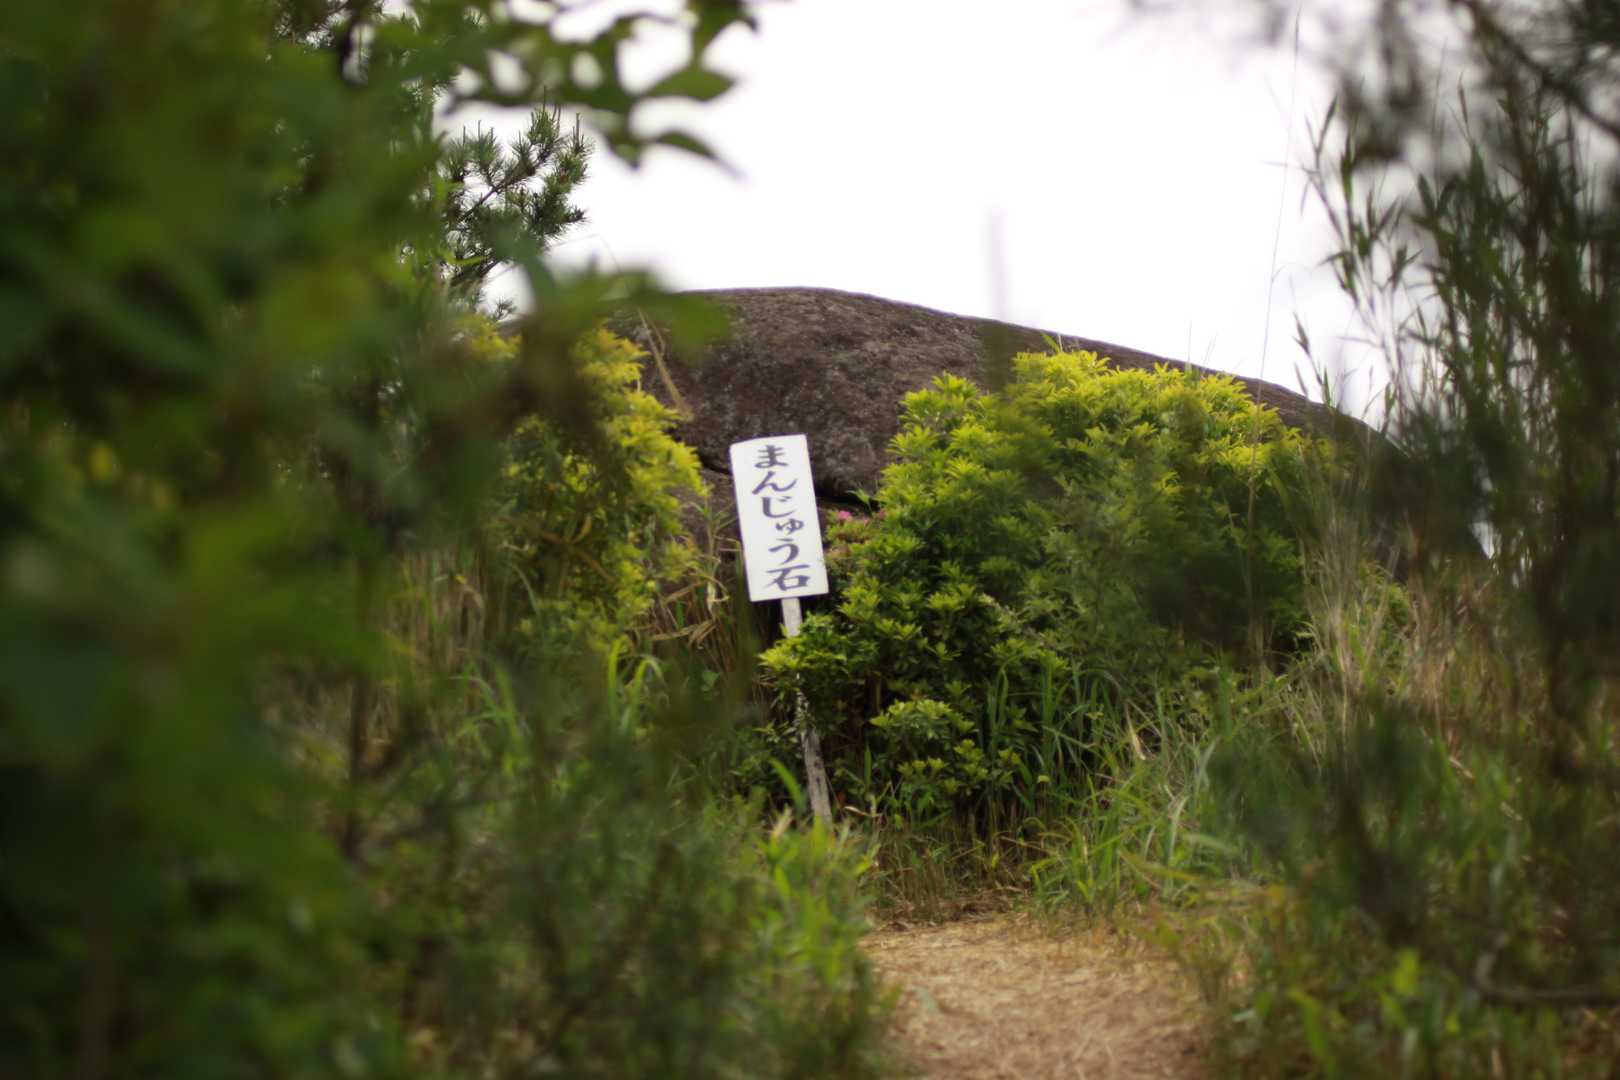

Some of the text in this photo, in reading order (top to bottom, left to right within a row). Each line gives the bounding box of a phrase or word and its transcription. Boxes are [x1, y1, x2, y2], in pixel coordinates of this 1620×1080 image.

[752, 445, 811, 591] まんじゅう石
